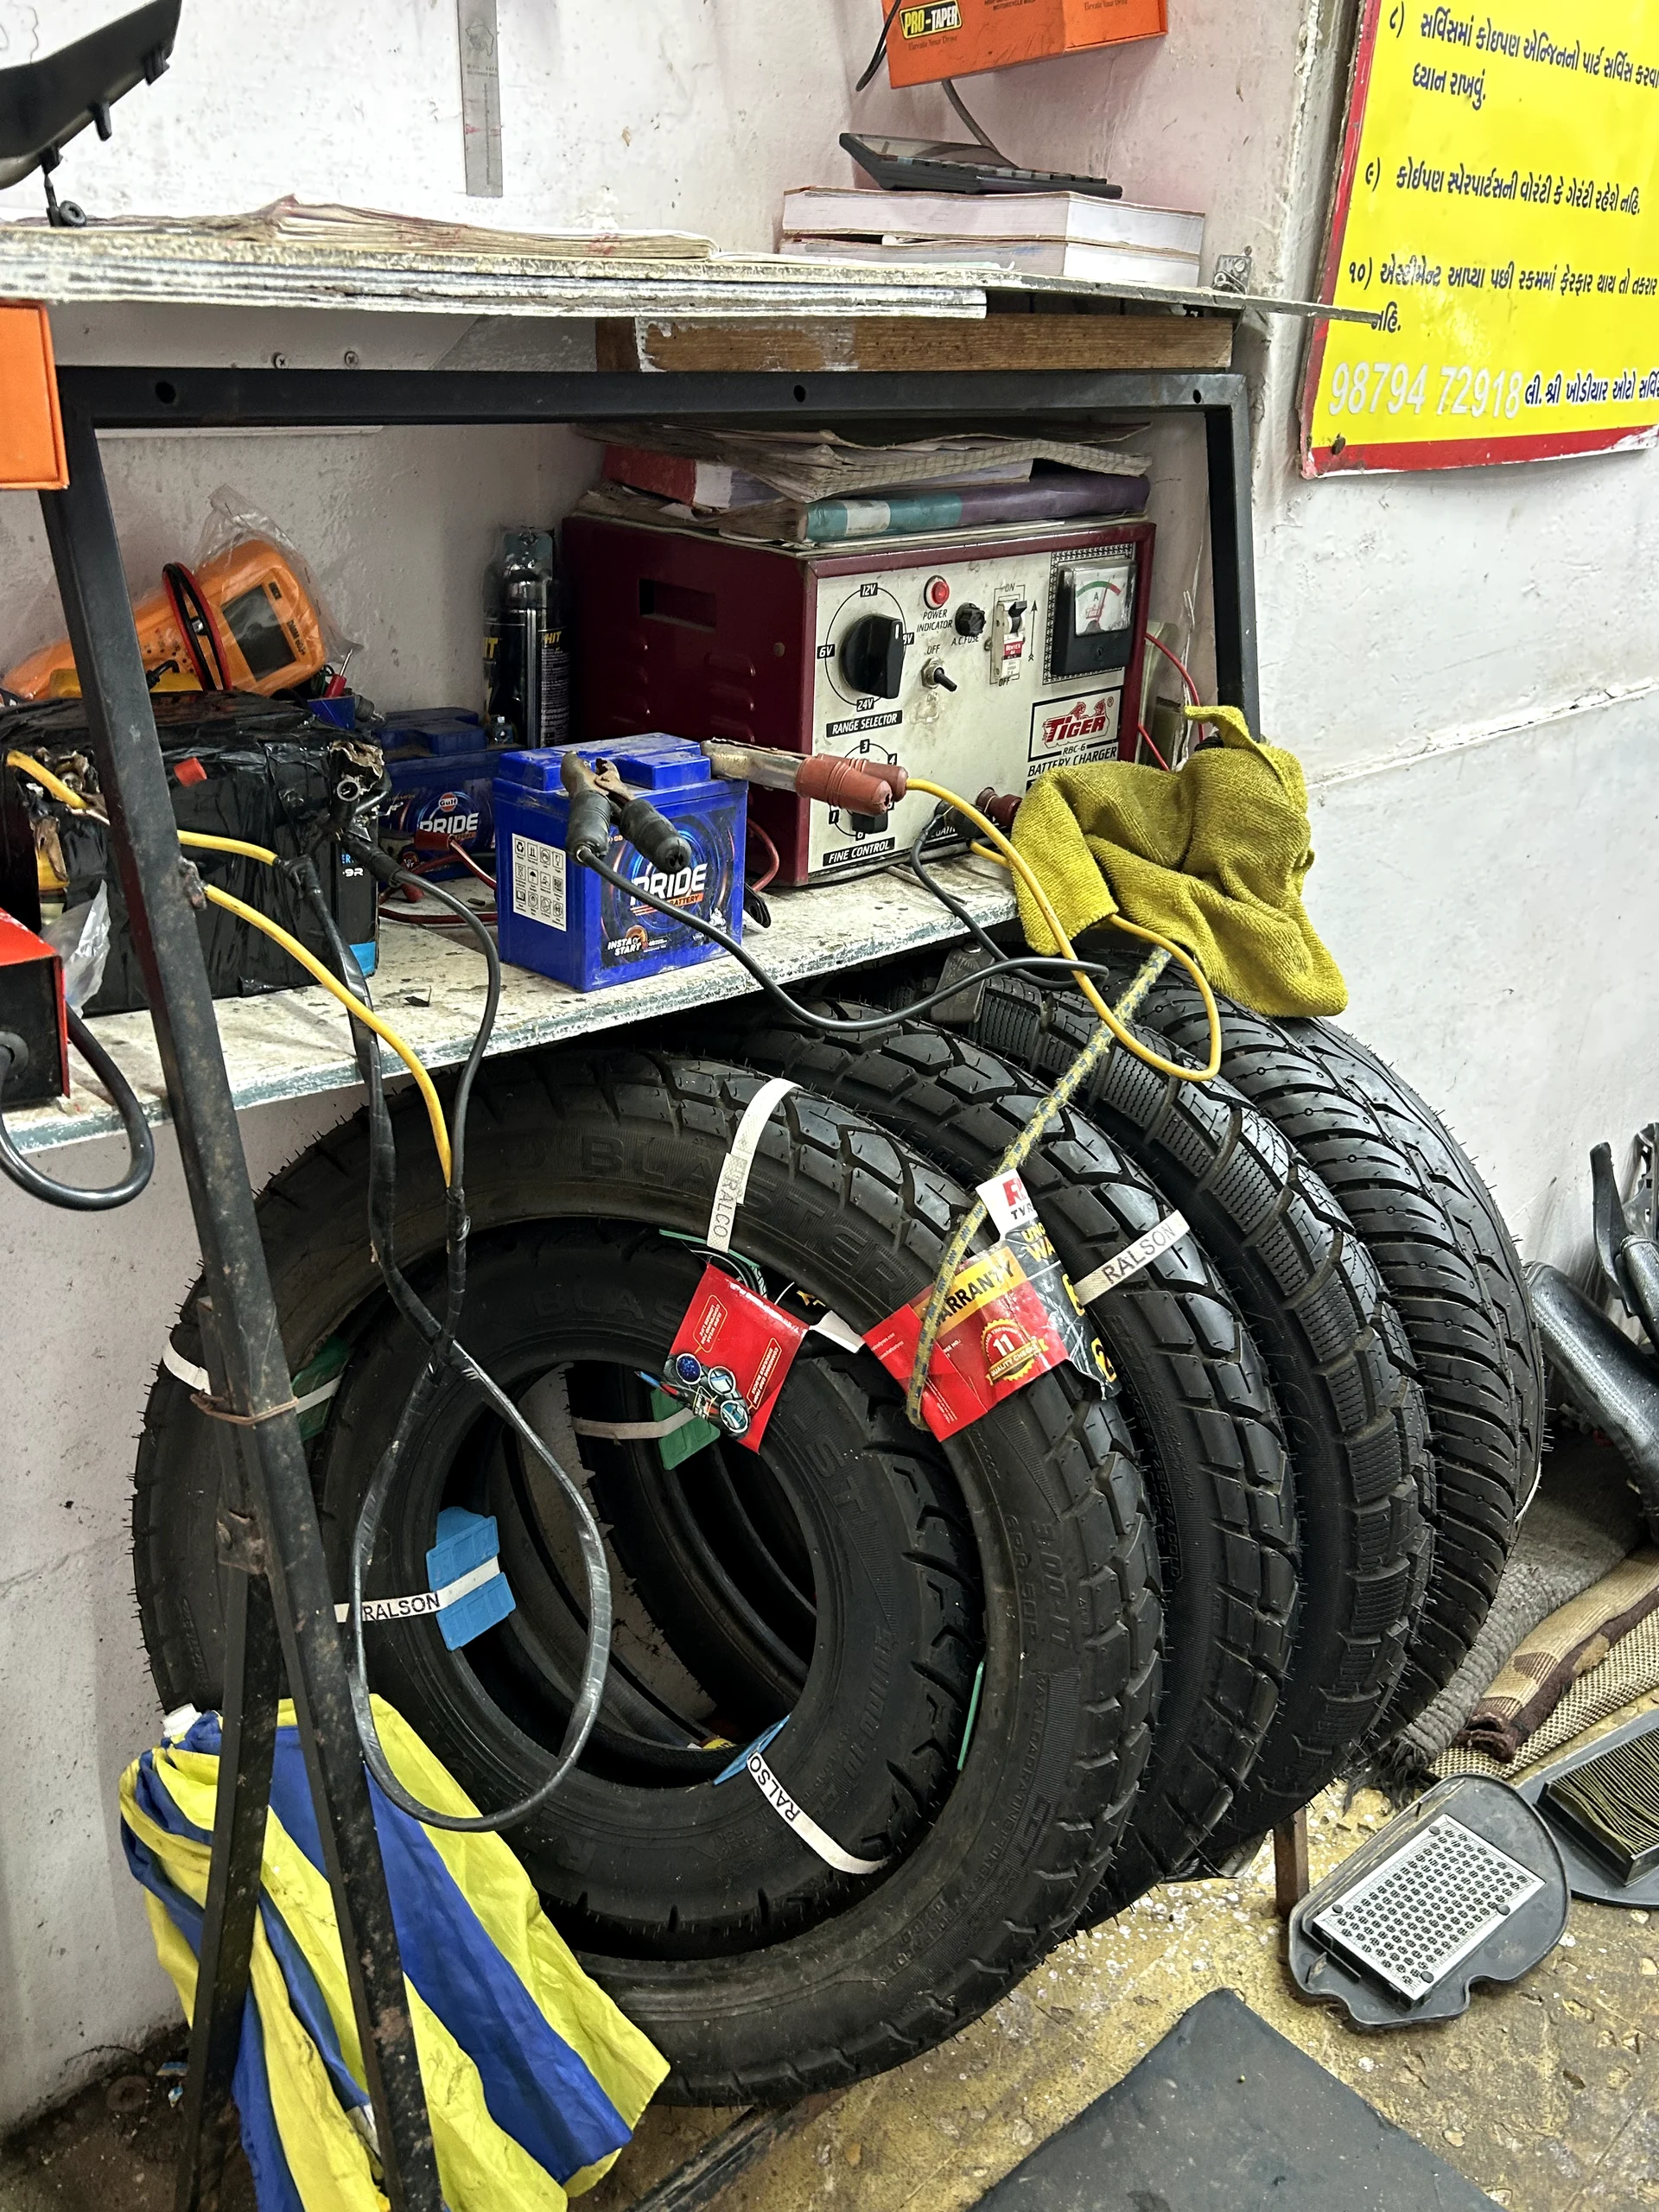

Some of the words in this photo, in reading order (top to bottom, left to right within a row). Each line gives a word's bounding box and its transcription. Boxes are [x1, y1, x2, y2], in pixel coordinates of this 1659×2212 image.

[1421, 6, 1474, 47] સર્વિસમાં
[1582, 46, 1605, 75] પાર્ટ
[1604, 50, 1633, 82] સર્વિસ
[1635, 65, 1659, 89] કરવા
[1413, 61, 1447, 93] ધ્યાન
[1450, 68, 1486, 111] રાખવું.
[1396, 156, 1445, 193] કોઈપણ
[1520, 171, 1552, 204] વોરંટી
[1554, 175, 1564, 205] કે
[1595, 181, 1619, 212] રહેશે
[1447, 266, 1486, 289] આપ્યા
[1491, 260, 1515, 289] પછી
[1518, 264, 1558, 291] રકમમાં
[1560, 264, 1593, 296] ફેરફાર
[1597, 274, 1616, 294] થાય
[1618, 267, 1630, 295] તો
[1328, 361, 1428, 416] 98794
[1436, 365, 1523, 419] 72918
[1545, 372, 1562, 404] શ્રી
[1566, 372, 1609, 403] ખોડીયાર
[1612, 371, 1636, 400] ઓટો
[1638, 370, 1659, 398] સર્વિ
[861, 584, 877, 597] 12V
[1093, 591, 1099, 601] A
[923, 609, 947, 620] POWER
[917, 620, 953, 632] INDICATOR
[483, 637, 499, 659] IT
[544, 632, 563, 645] HIT
[926, 644, 940, 655] OFF
[818, 645, 835, 658] 6V
[998, 677, 1011, 687] OFF
[857, 698, 874, 711] 24V
[832, 718, 860, 735] RANGE
[861, 713, 898, 732] SELECTOR
[862, 741, 868, 753] 3
[1063, 743, 1086, 756] RBC-6
[1027, 757, 1071, 777] BATTERY
[1072, 747, 1117, 766] CHARGER
[419, 813, 480, 835] PRIDE
[829, 849, 849, 863] FINE
[851, 840, 891, 859] CONTROL
[631, 863, 708, 906] PRIDE
[607, 938, 630, 950] INSTA
[614, 942, 642, 957] START
[713, 1176, 740, 1238] RALCO
[1010, 1204, 1034, 1221] TYR
[1025, 1236, 1057, 1263] WA
[1101, 1221, 1178, 1285] RALSON
[938, 1260, 1015, 1323] ARRANTY
[993, 1334, 1015, 1357] 11
[990, 1358, 1013, 1377] QUALITY
[362, 1592, 441, 1622] RALSON
[747, 1751, 801, 1822] RALSO
